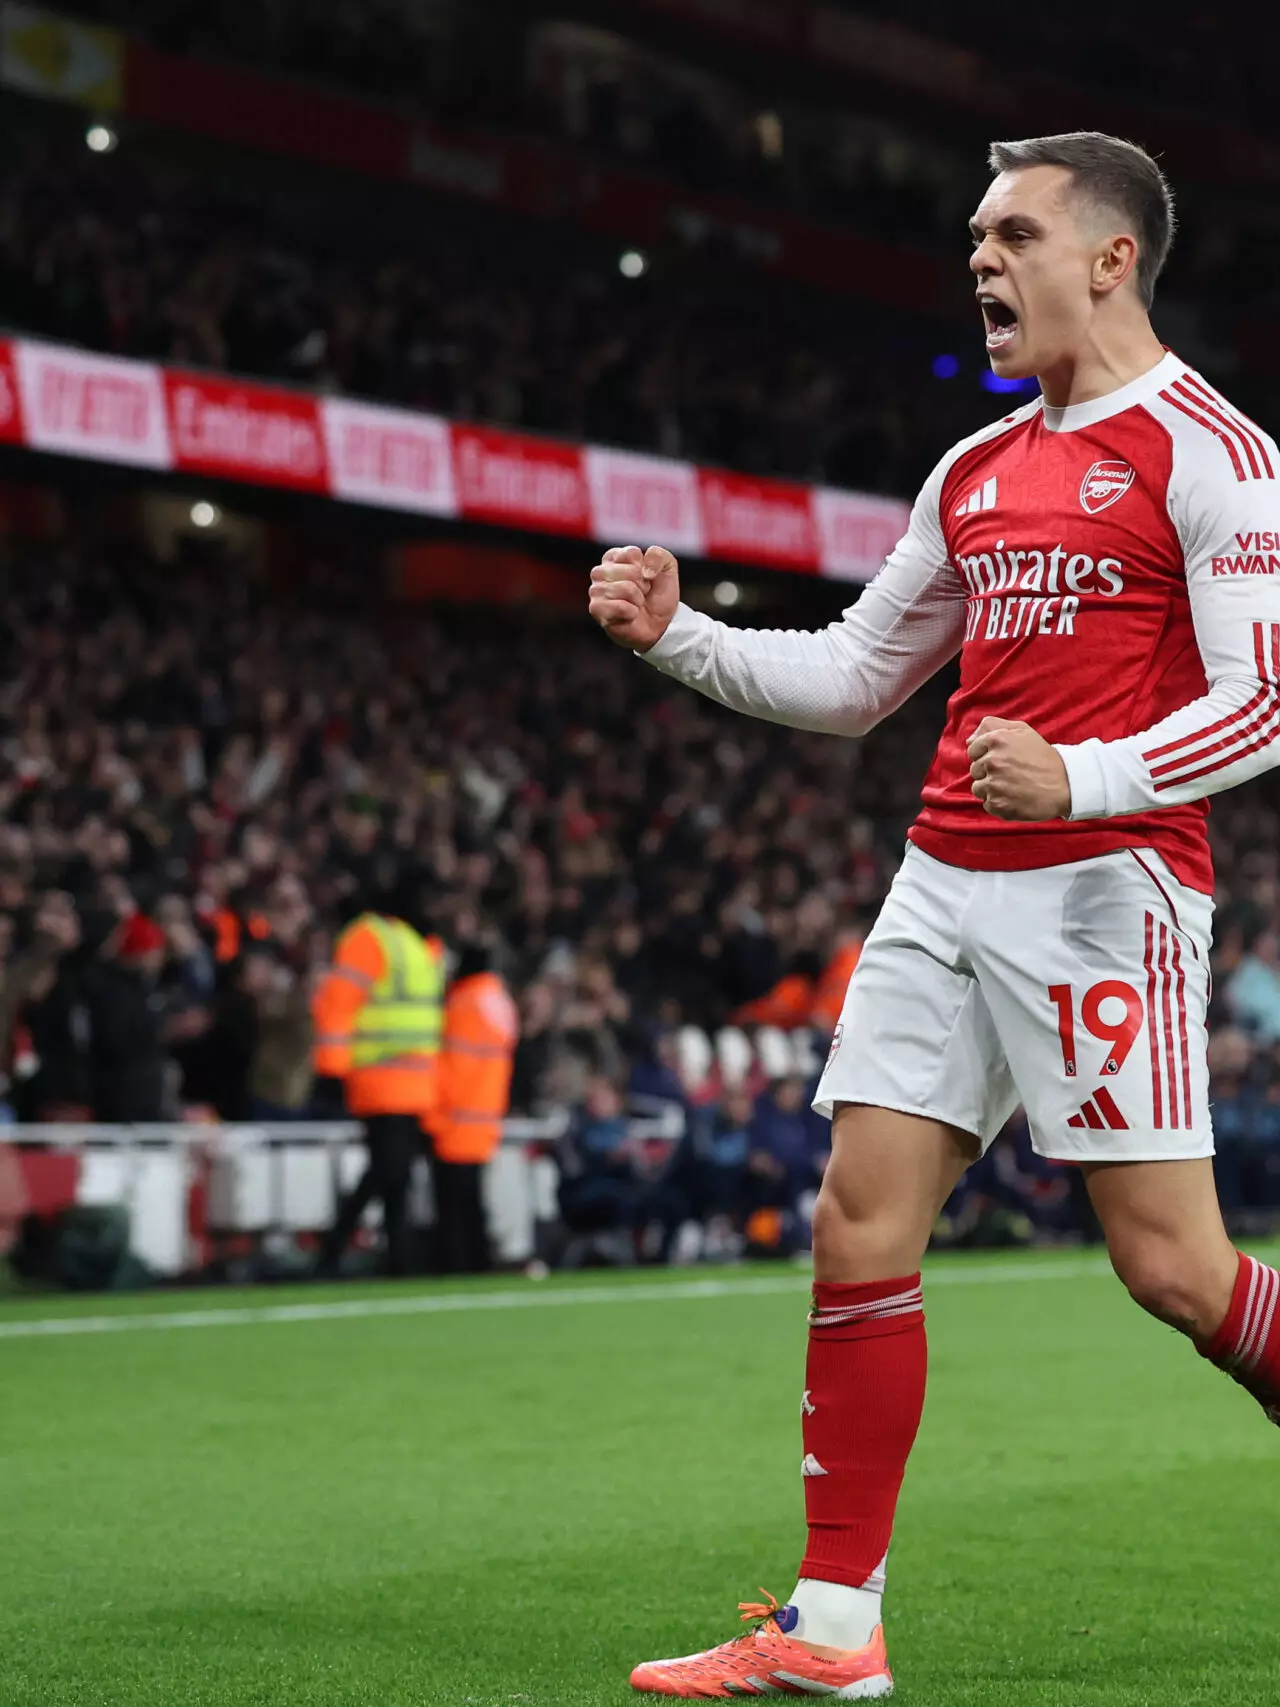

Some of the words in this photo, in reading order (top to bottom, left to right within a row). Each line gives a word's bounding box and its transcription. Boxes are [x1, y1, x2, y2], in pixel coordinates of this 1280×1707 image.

[1092, 468, 1128, 480] Arsenal
[955, 539, 1124, 598] mirates
[985, 595, 1080, 641] BETTER
[1047, 979, 1144, 1077] 19
